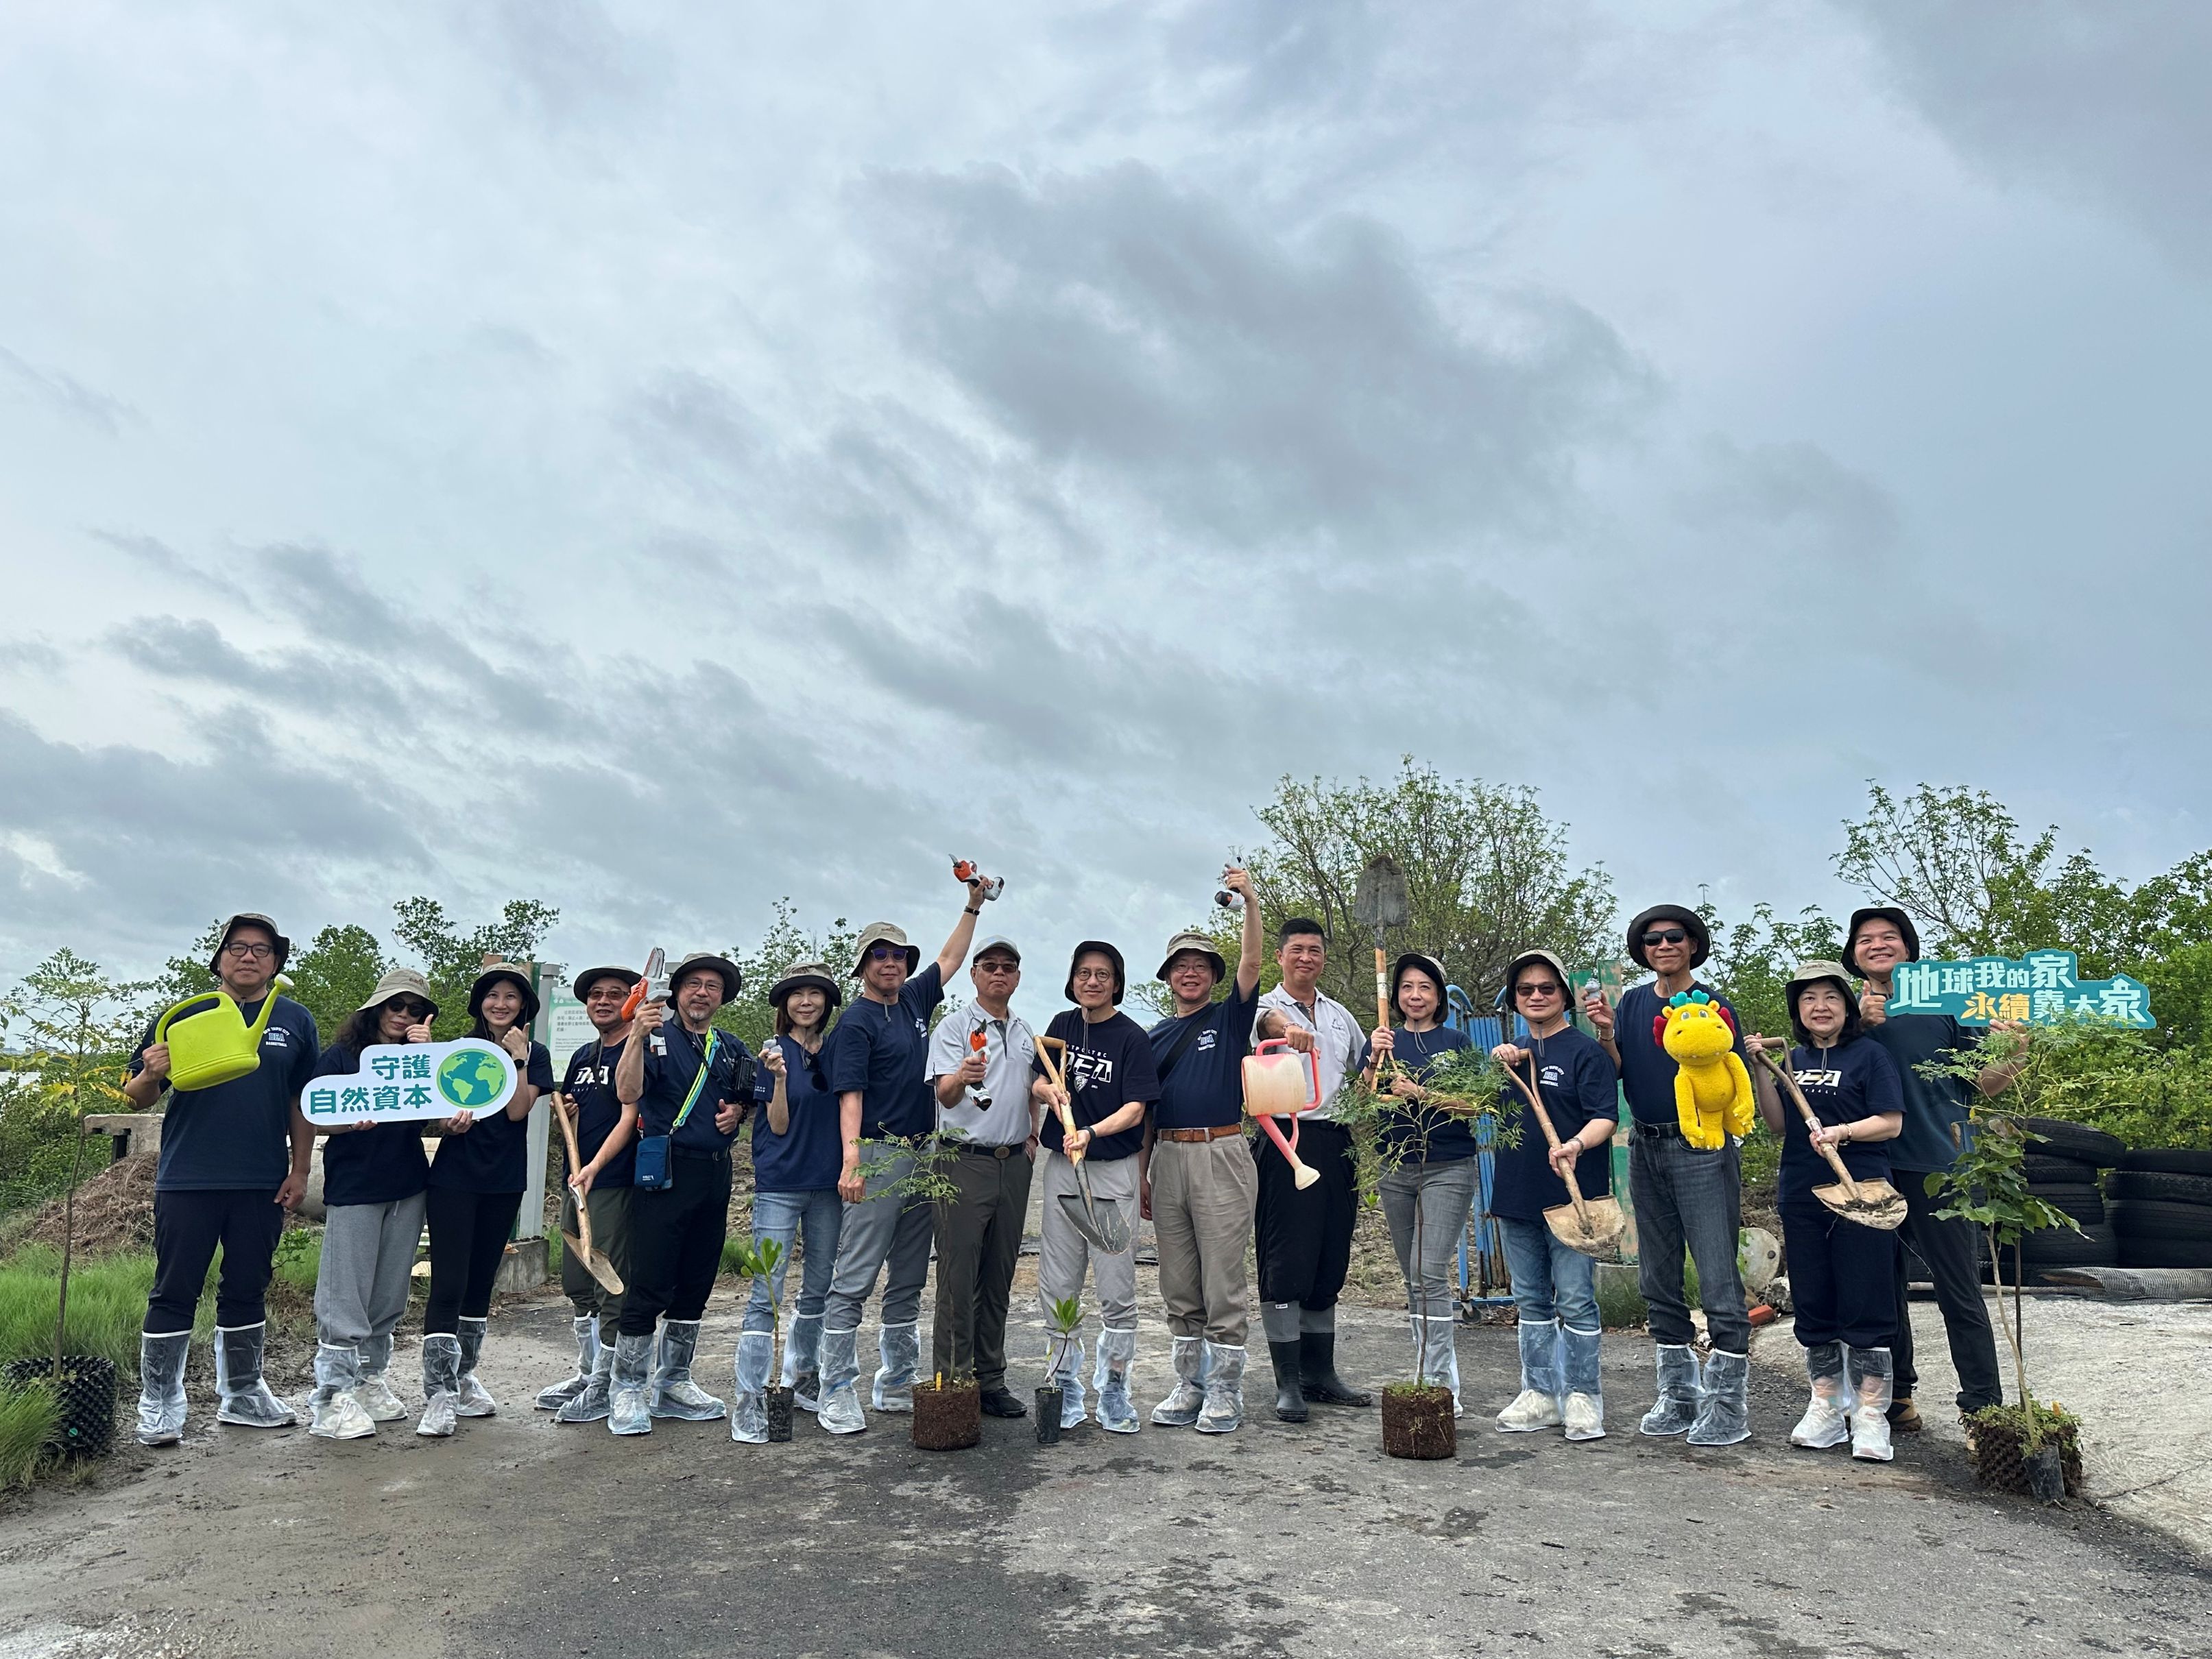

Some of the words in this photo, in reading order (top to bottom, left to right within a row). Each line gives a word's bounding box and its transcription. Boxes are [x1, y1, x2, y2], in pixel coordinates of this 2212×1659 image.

[1890, 954, 2076, 1010] 地球我的家
[1960, 978, 2148, 1022] 永續靠大家
[371, 1054, 431, 1080] 守護
[310, 1084, 433, 1115] 自然資本
